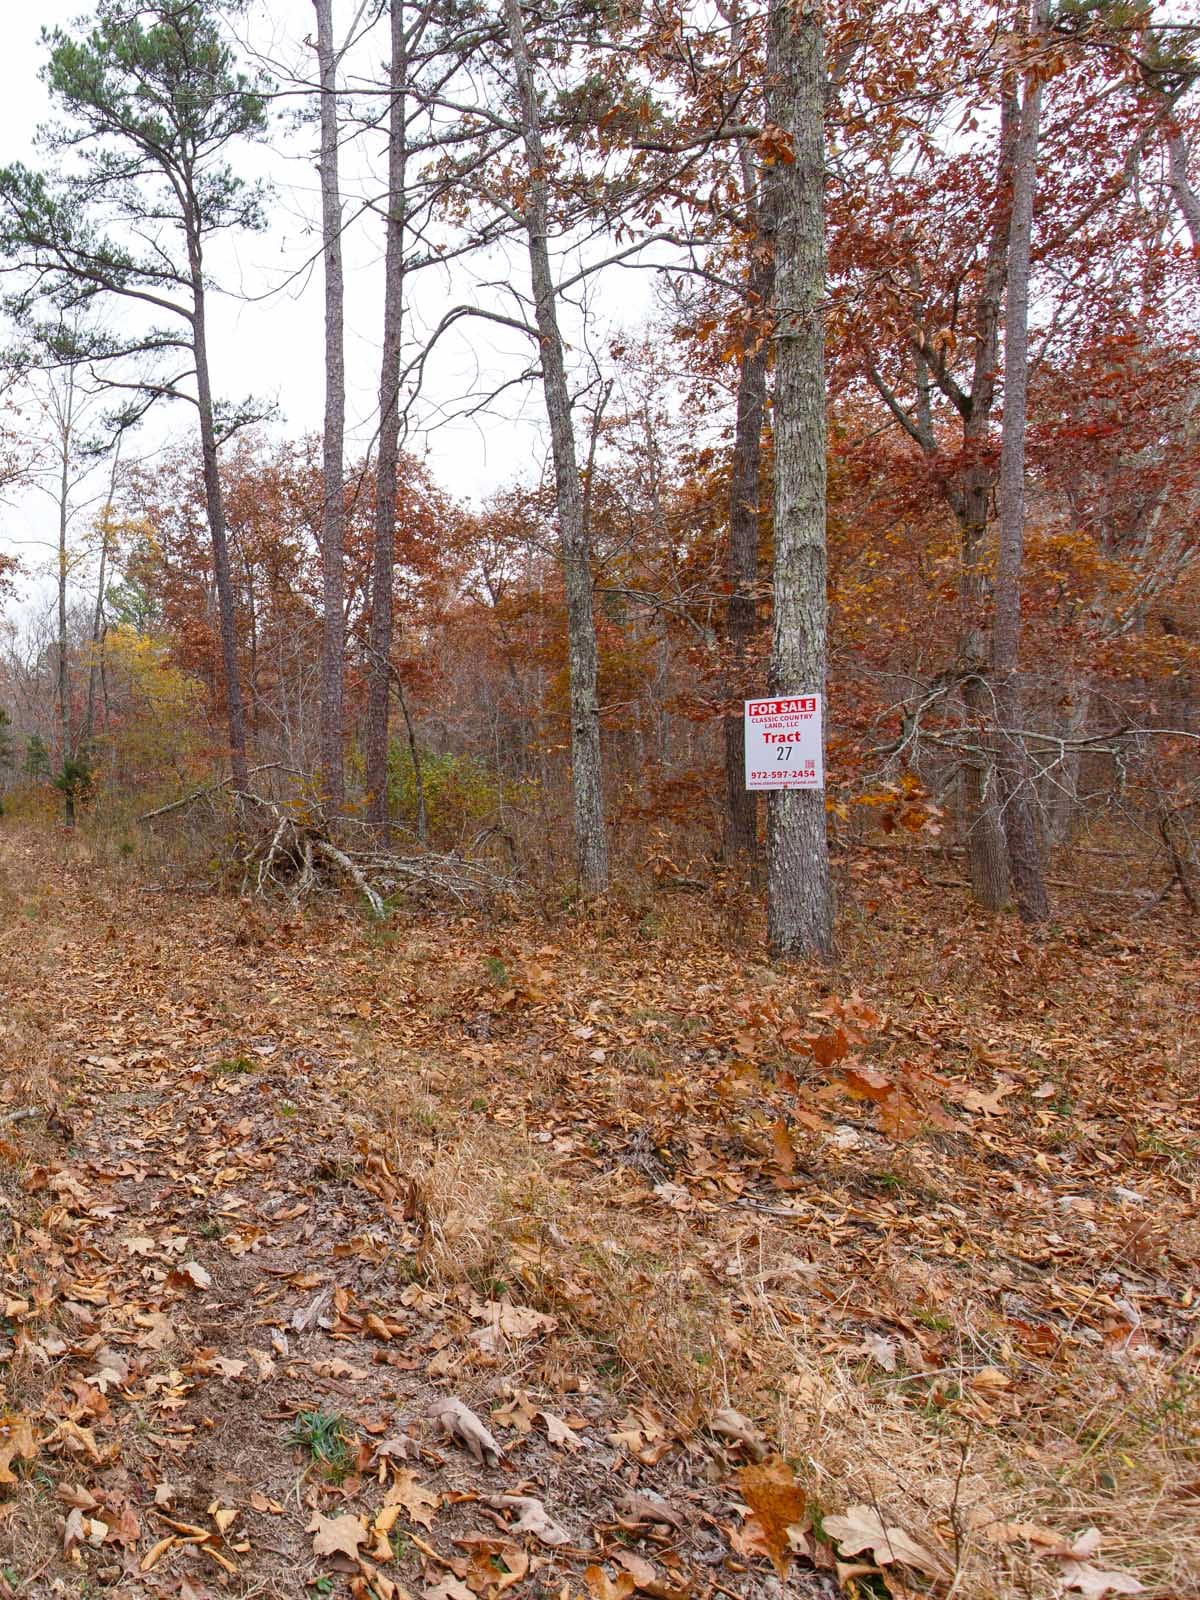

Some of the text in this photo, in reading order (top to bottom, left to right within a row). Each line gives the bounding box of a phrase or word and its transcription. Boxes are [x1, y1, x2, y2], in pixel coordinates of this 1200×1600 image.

[751, 700, 814, 715] FOR SALE
[762, 731, 801, 744] Tract
[776, 746, 793, 760] 27
[751, 770, 815, 779] 972-597-2454
